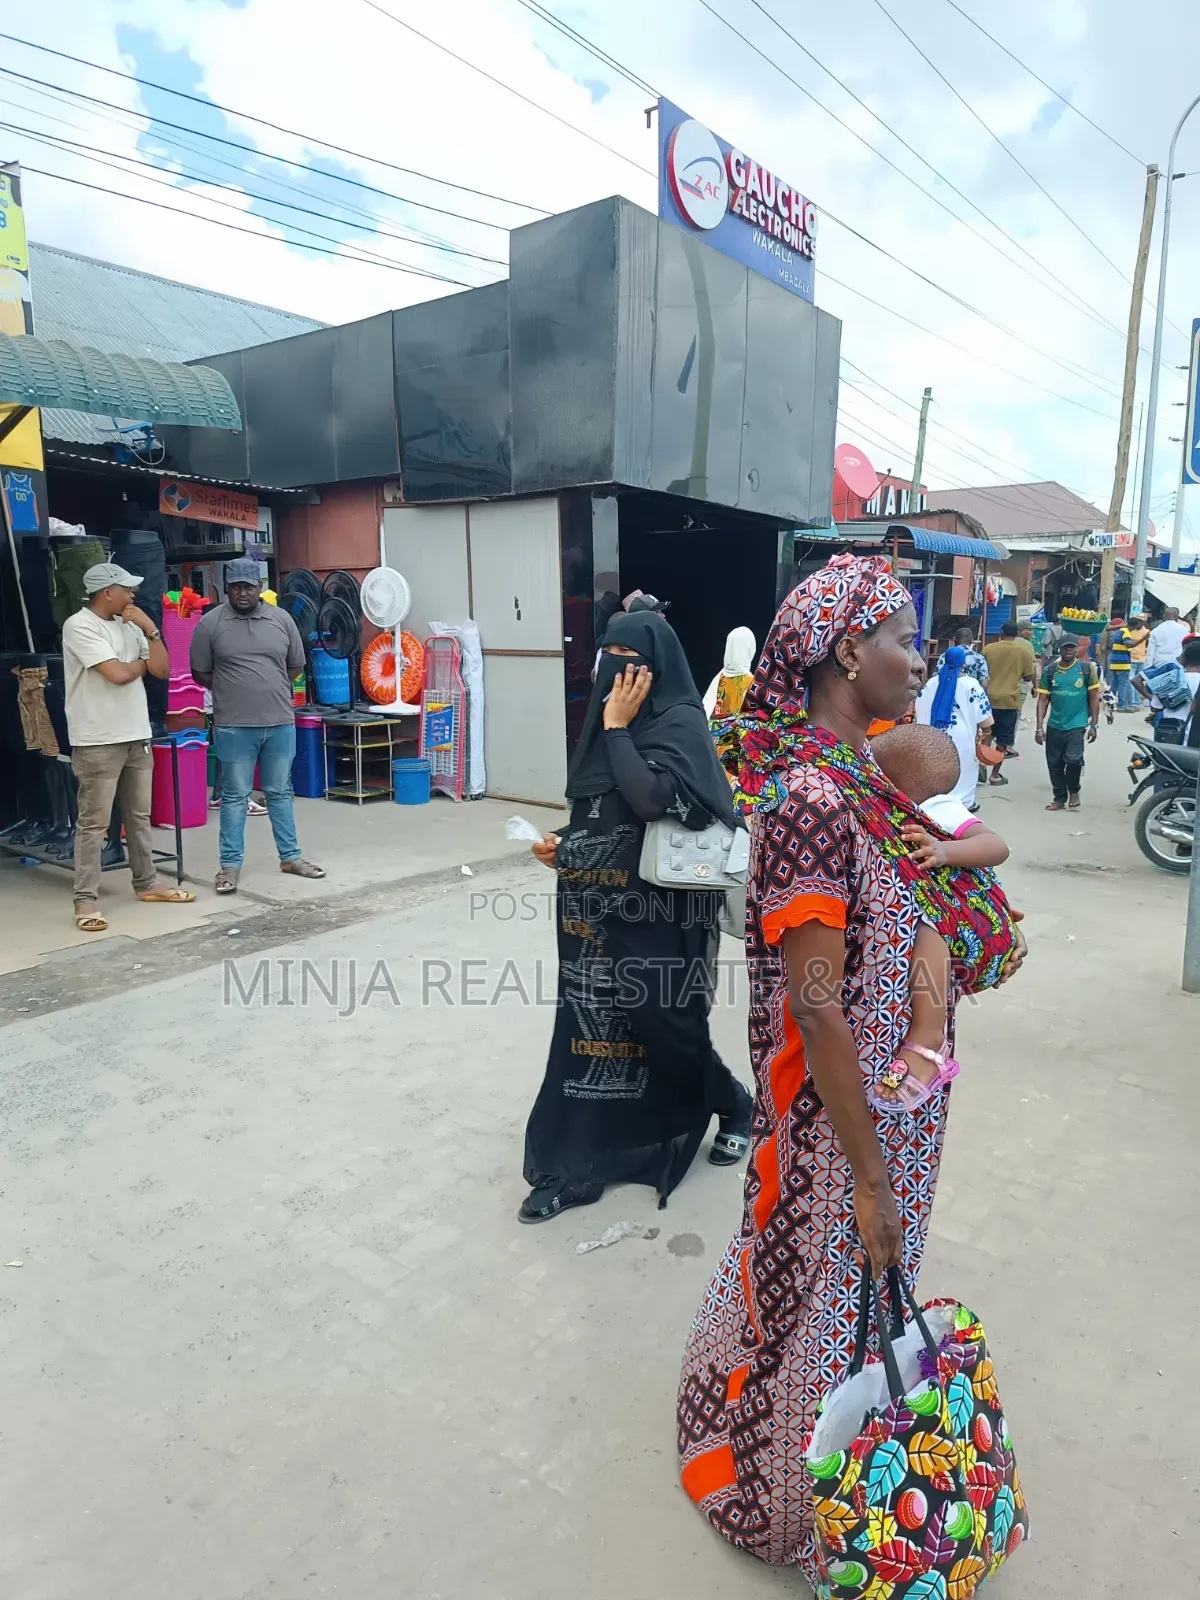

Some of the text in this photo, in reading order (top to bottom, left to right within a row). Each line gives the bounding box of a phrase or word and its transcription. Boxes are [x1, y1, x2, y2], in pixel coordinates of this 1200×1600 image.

[726, 147, 818, 238] GAUCHO
[730, 186, 817, 261] ELECTRONICS
[752, 227, 793, 266] WAKALA
[195, 489, 258, 513] StarTimes
[208, 507, 247, 522] WAKALA
